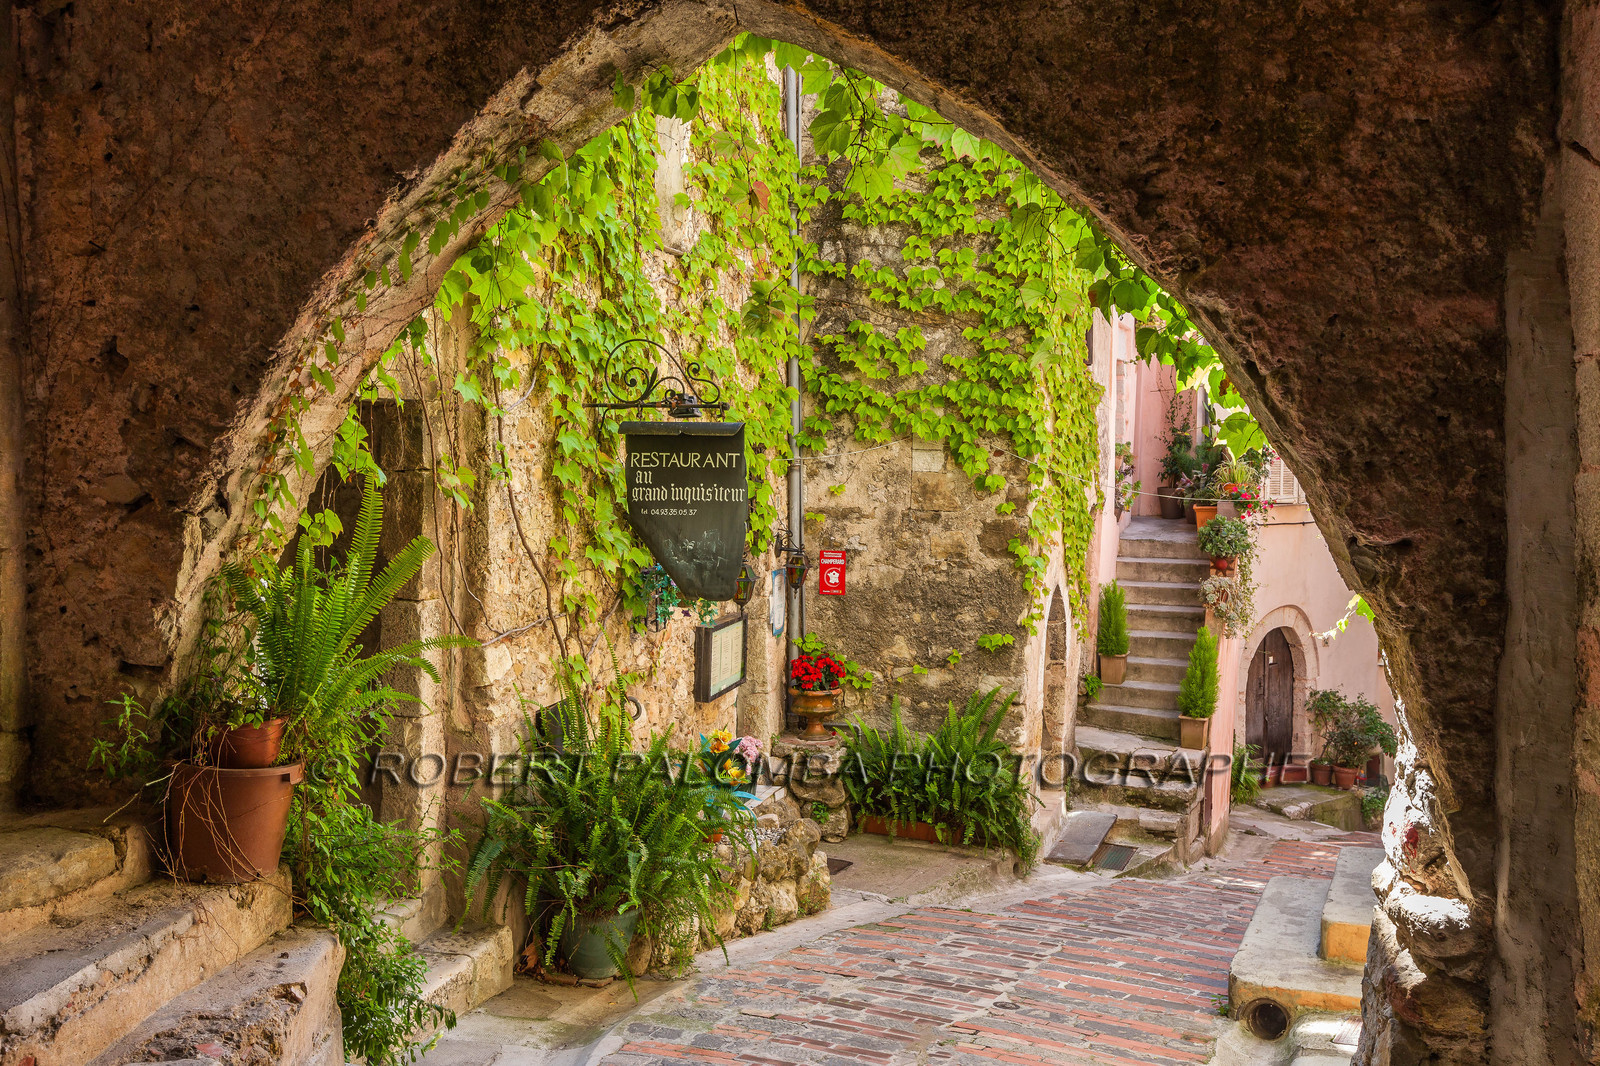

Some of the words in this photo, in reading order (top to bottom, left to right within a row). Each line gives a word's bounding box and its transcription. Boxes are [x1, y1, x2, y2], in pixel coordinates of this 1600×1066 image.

[630, 452, 740, 468] RESTAURANT
[635, 470, 652, 484] au
[632, 486, 668, 502] grand
[670, 483, 746, 504] inquisiteur
